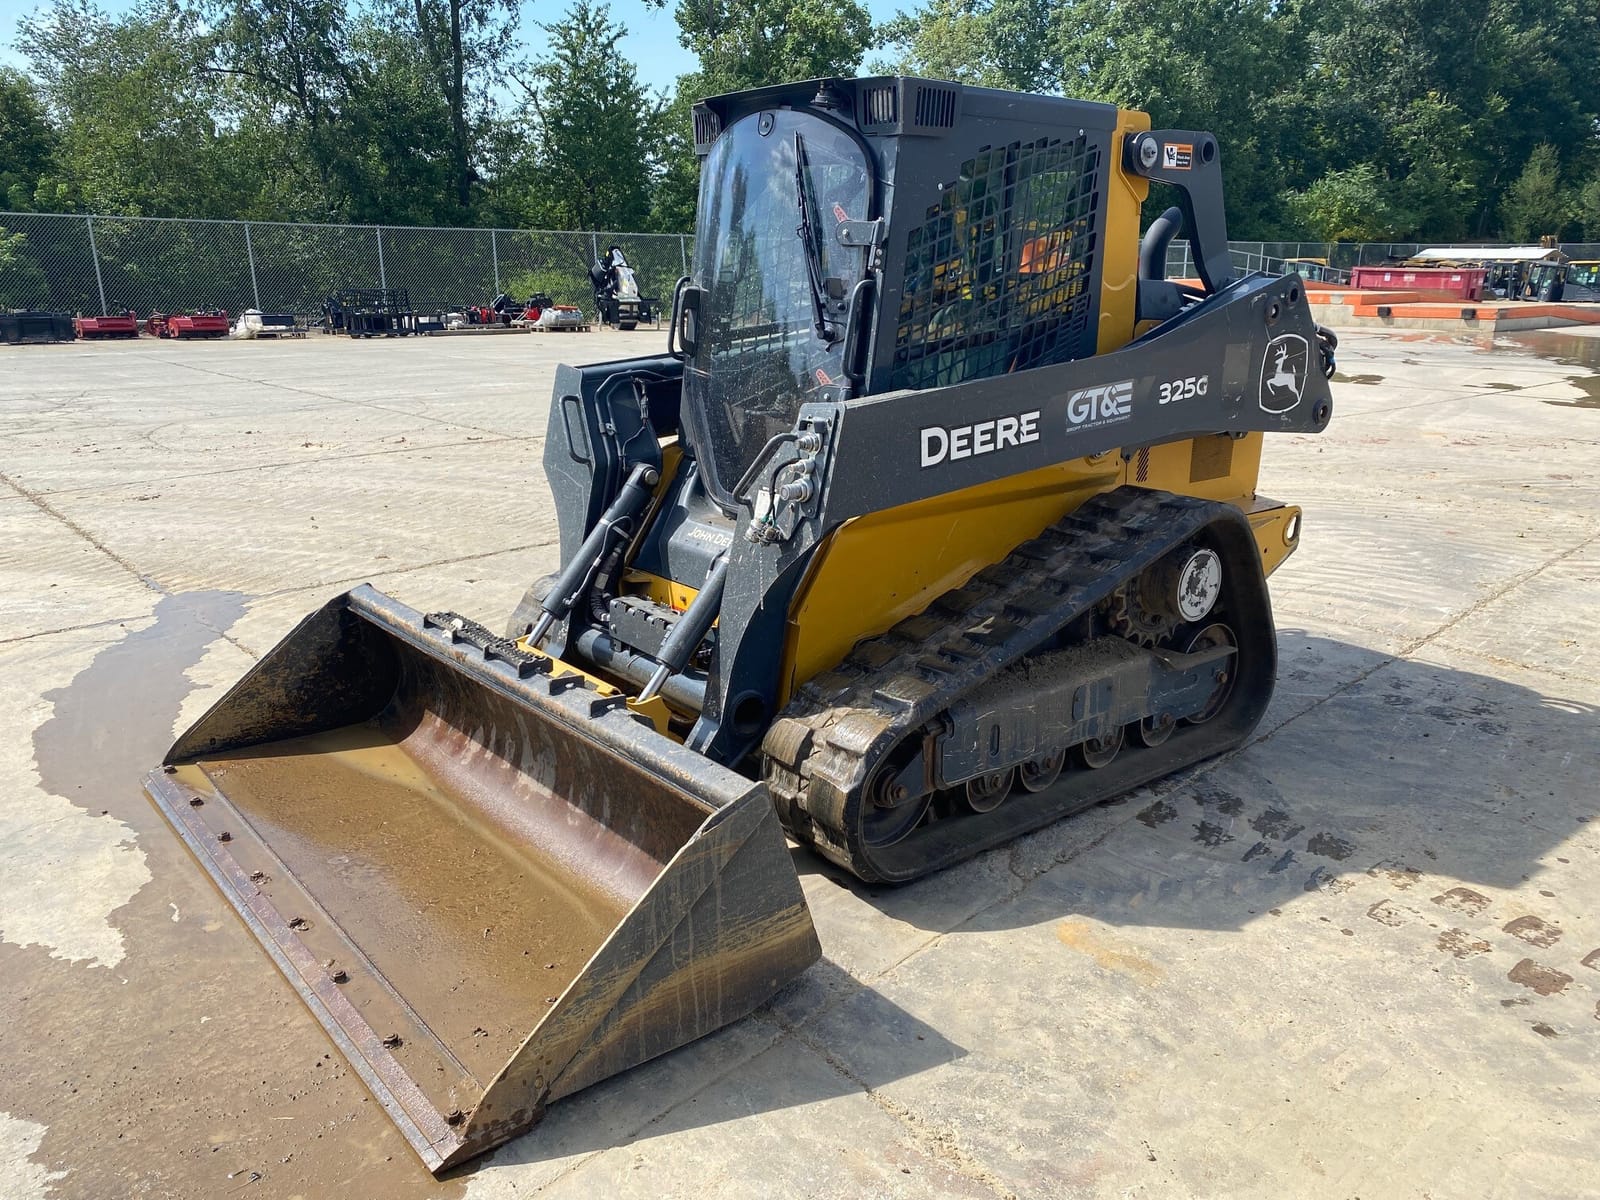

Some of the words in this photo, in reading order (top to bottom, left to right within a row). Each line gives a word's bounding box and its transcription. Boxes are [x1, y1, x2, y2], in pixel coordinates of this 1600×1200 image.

[1067, 382, 1133, 424] GT&E
[1158, 375, 1209, 405] 325G
[920, 411, 1041, 468] DEERE
[687, 526, 716, 542] JOHN
